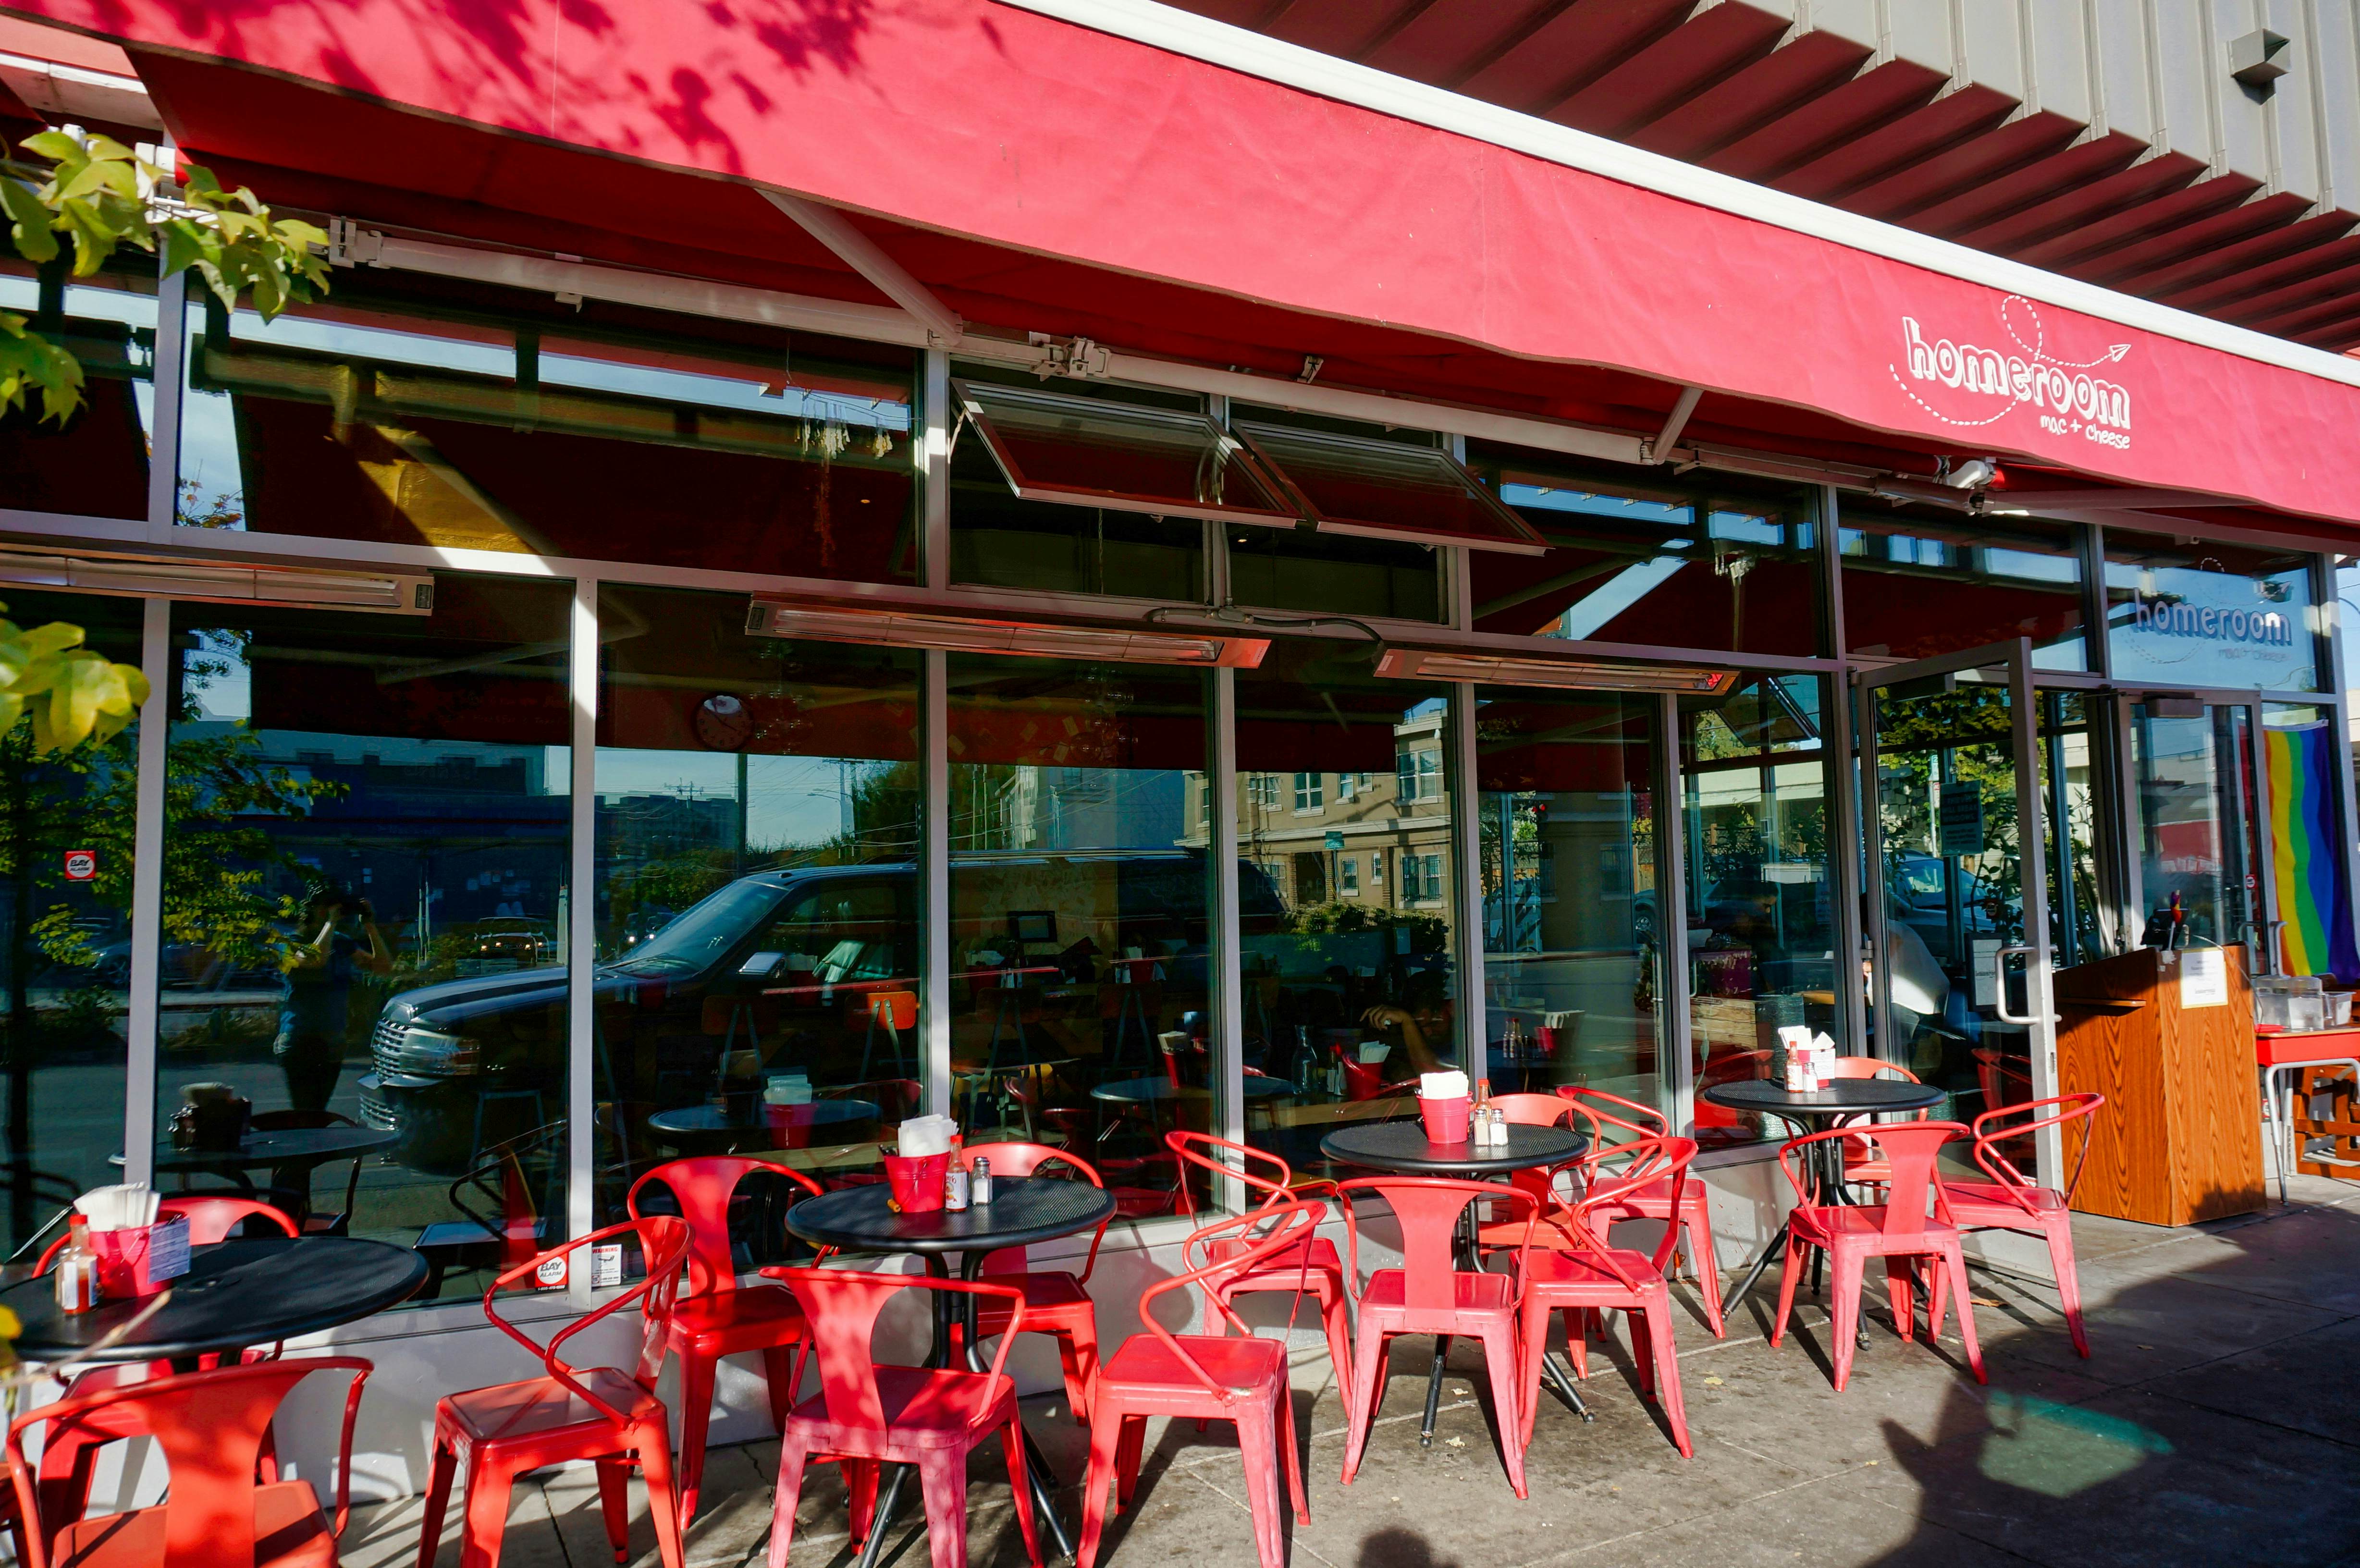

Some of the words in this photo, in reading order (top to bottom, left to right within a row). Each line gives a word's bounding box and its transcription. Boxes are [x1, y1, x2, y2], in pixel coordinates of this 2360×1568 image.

[1902, 316, 2131, 429] homeroom
[2040, 414, 2067, 435] mac
[2086, 423, 2130, 449] cheese
[2134, 587, 2292, 645] homeroom
[541, 1262, 562, 1271] BAY
